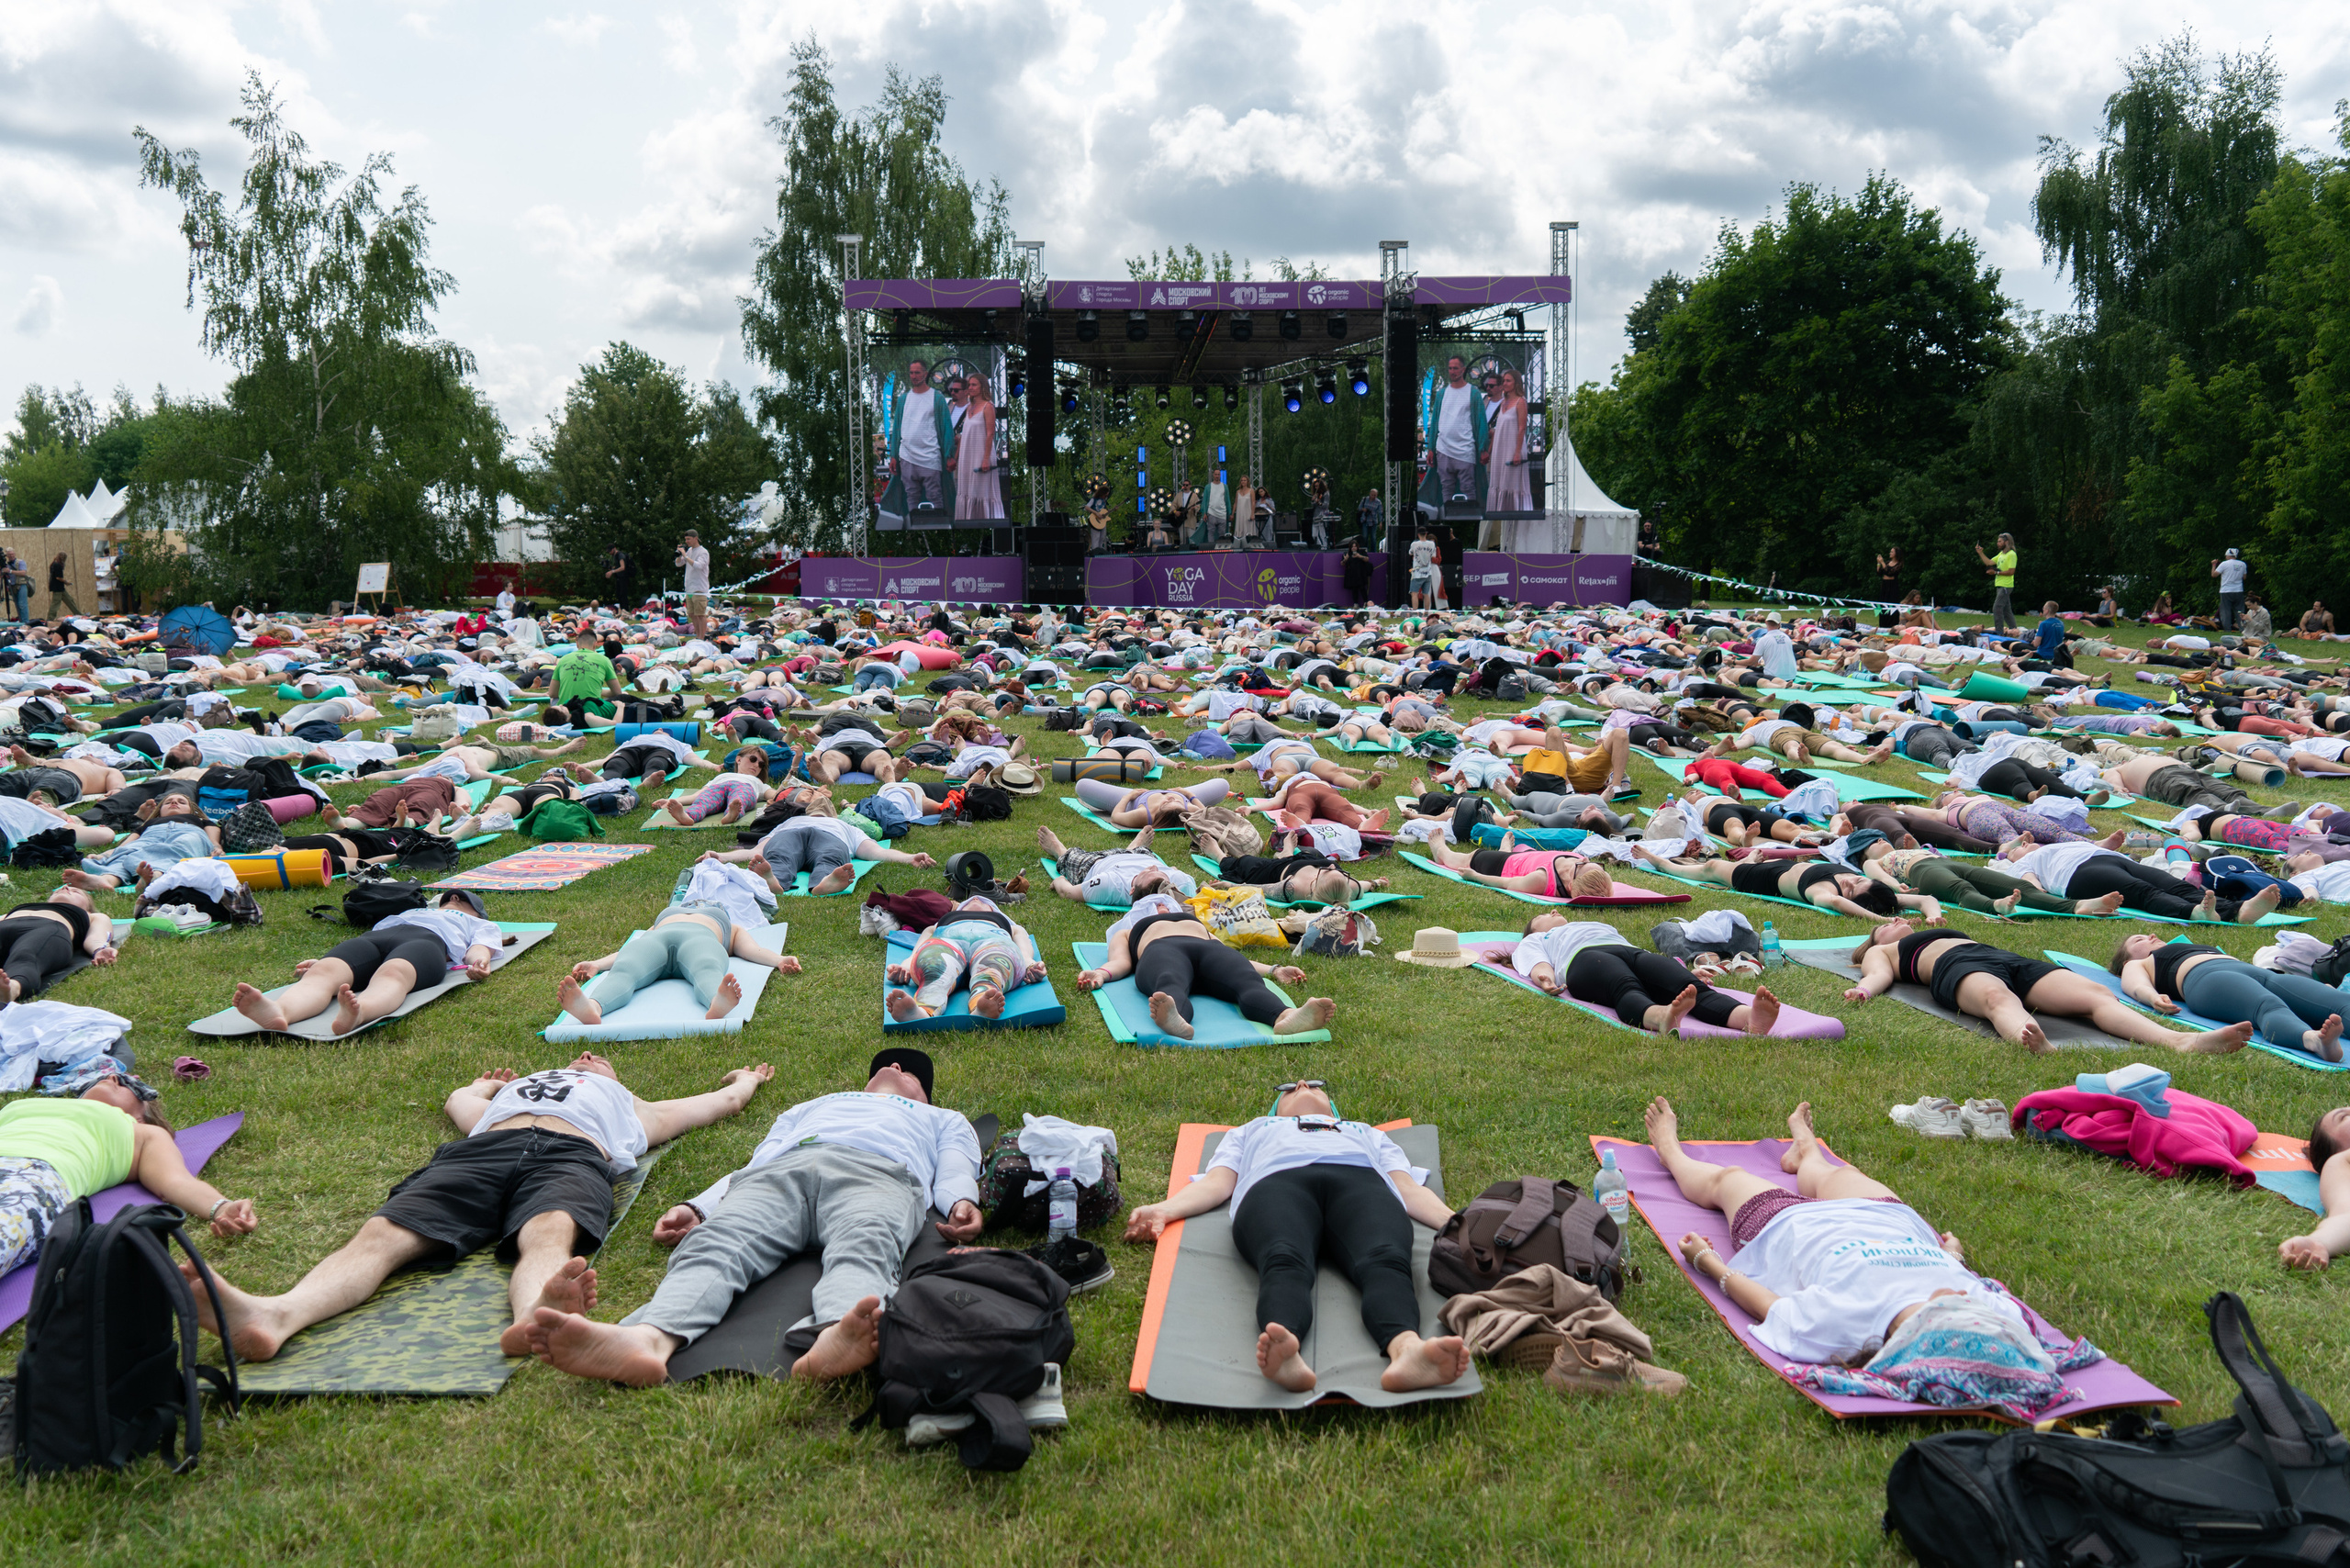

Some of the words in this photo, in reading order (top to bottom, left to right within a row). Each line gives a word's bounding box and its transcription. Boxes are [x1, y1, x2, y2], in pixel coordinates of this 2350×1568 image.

[1169, 286, 1211, 297] МОСКОВСКИЙ
[1169, 297, 1189, 306] СПОРТ
[1165, 567, 1204, 581] YOGA
[901, 577, 940, 587] МОСКОВСКИЙ
[1279, 577, 1301, 586] organic
[1484, 575, 1505, 584] Прайм
[901, 586, 920, 594] СПОРТ
[1168, 582, 1195, 594] DAY
[1279, 586, 1300, 595] people
[1168, 594, 1194, 602] RUSSIA
[1090, 878, 1101, 888] 3
